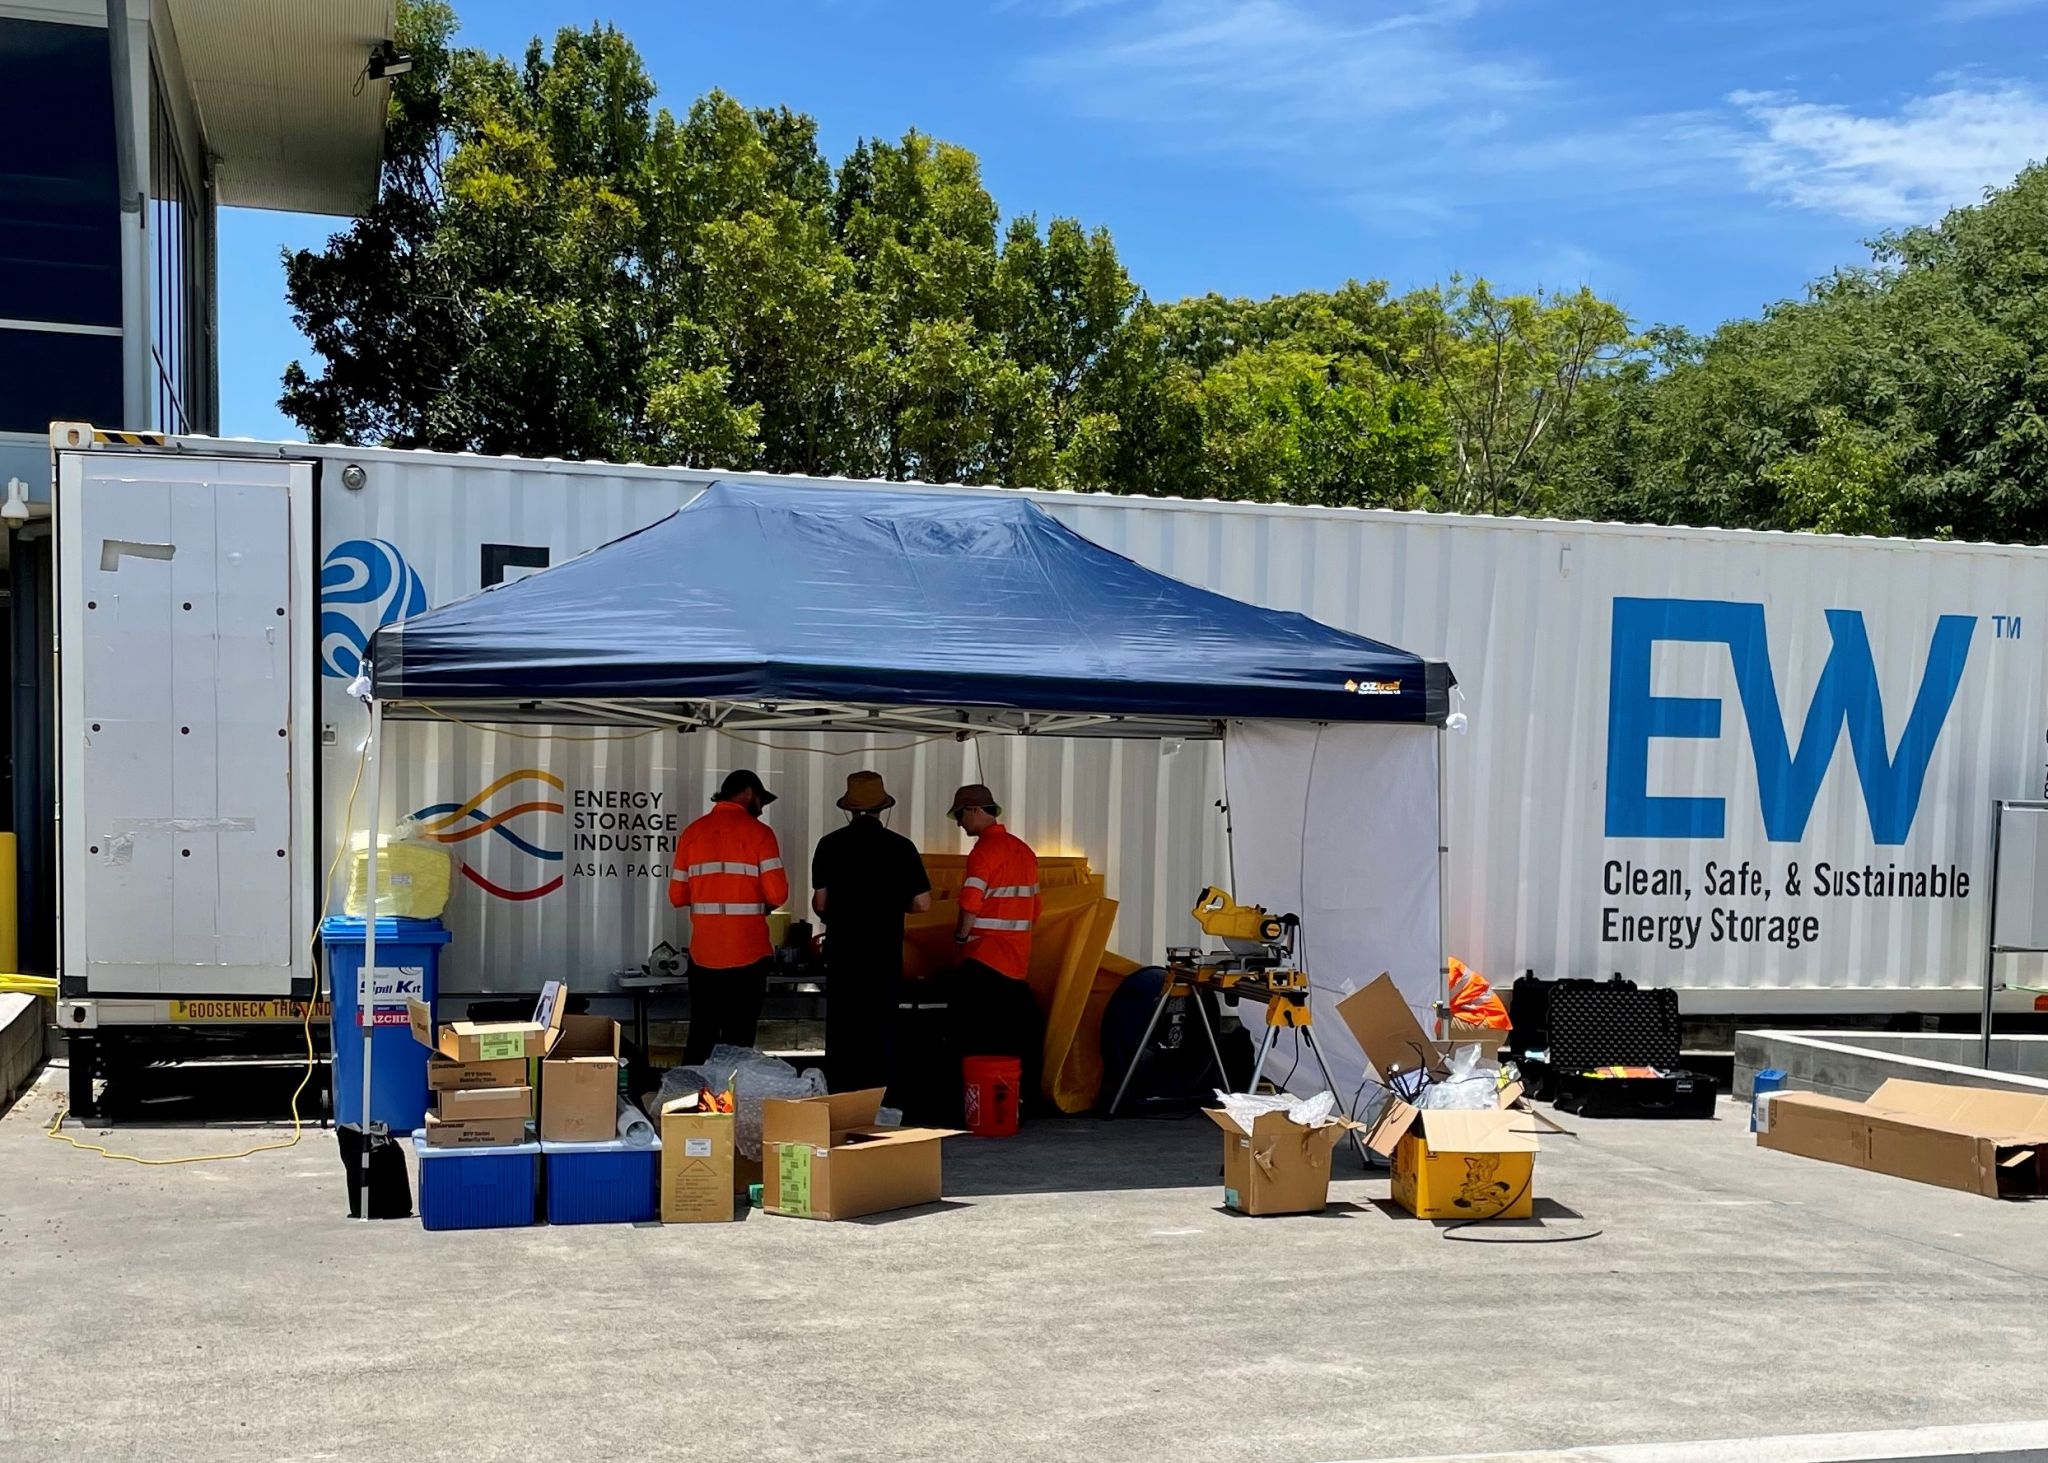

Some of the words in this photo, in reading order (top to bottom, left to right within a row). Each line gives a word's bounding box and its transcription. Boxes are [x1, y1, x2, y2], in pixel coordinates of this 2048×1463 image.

[1604, 597, 1978, 846] EW
[1992, 615, 2022, 639] TM
[574, 790, 663, 809] ENERGY
[574, 812, 677, 831] STORAGE
[574, 834, 677, 852] INDUSTRI
[573, 863, 618, 877] ASIA
[627, 864, 669, 878] PACI
[1604, 860, 1691, 901] Clean,
[1704, 861, 1771, 901] Safe,
[1785, 861, 1801, 896] &
[1813, 862, 1970, 898] Sustainable
[1602, 907, 1702, 949] Energy
[1710, 907, 1819, 949] Storage
[189, 1002, 267, 1018] GOOSENECK
